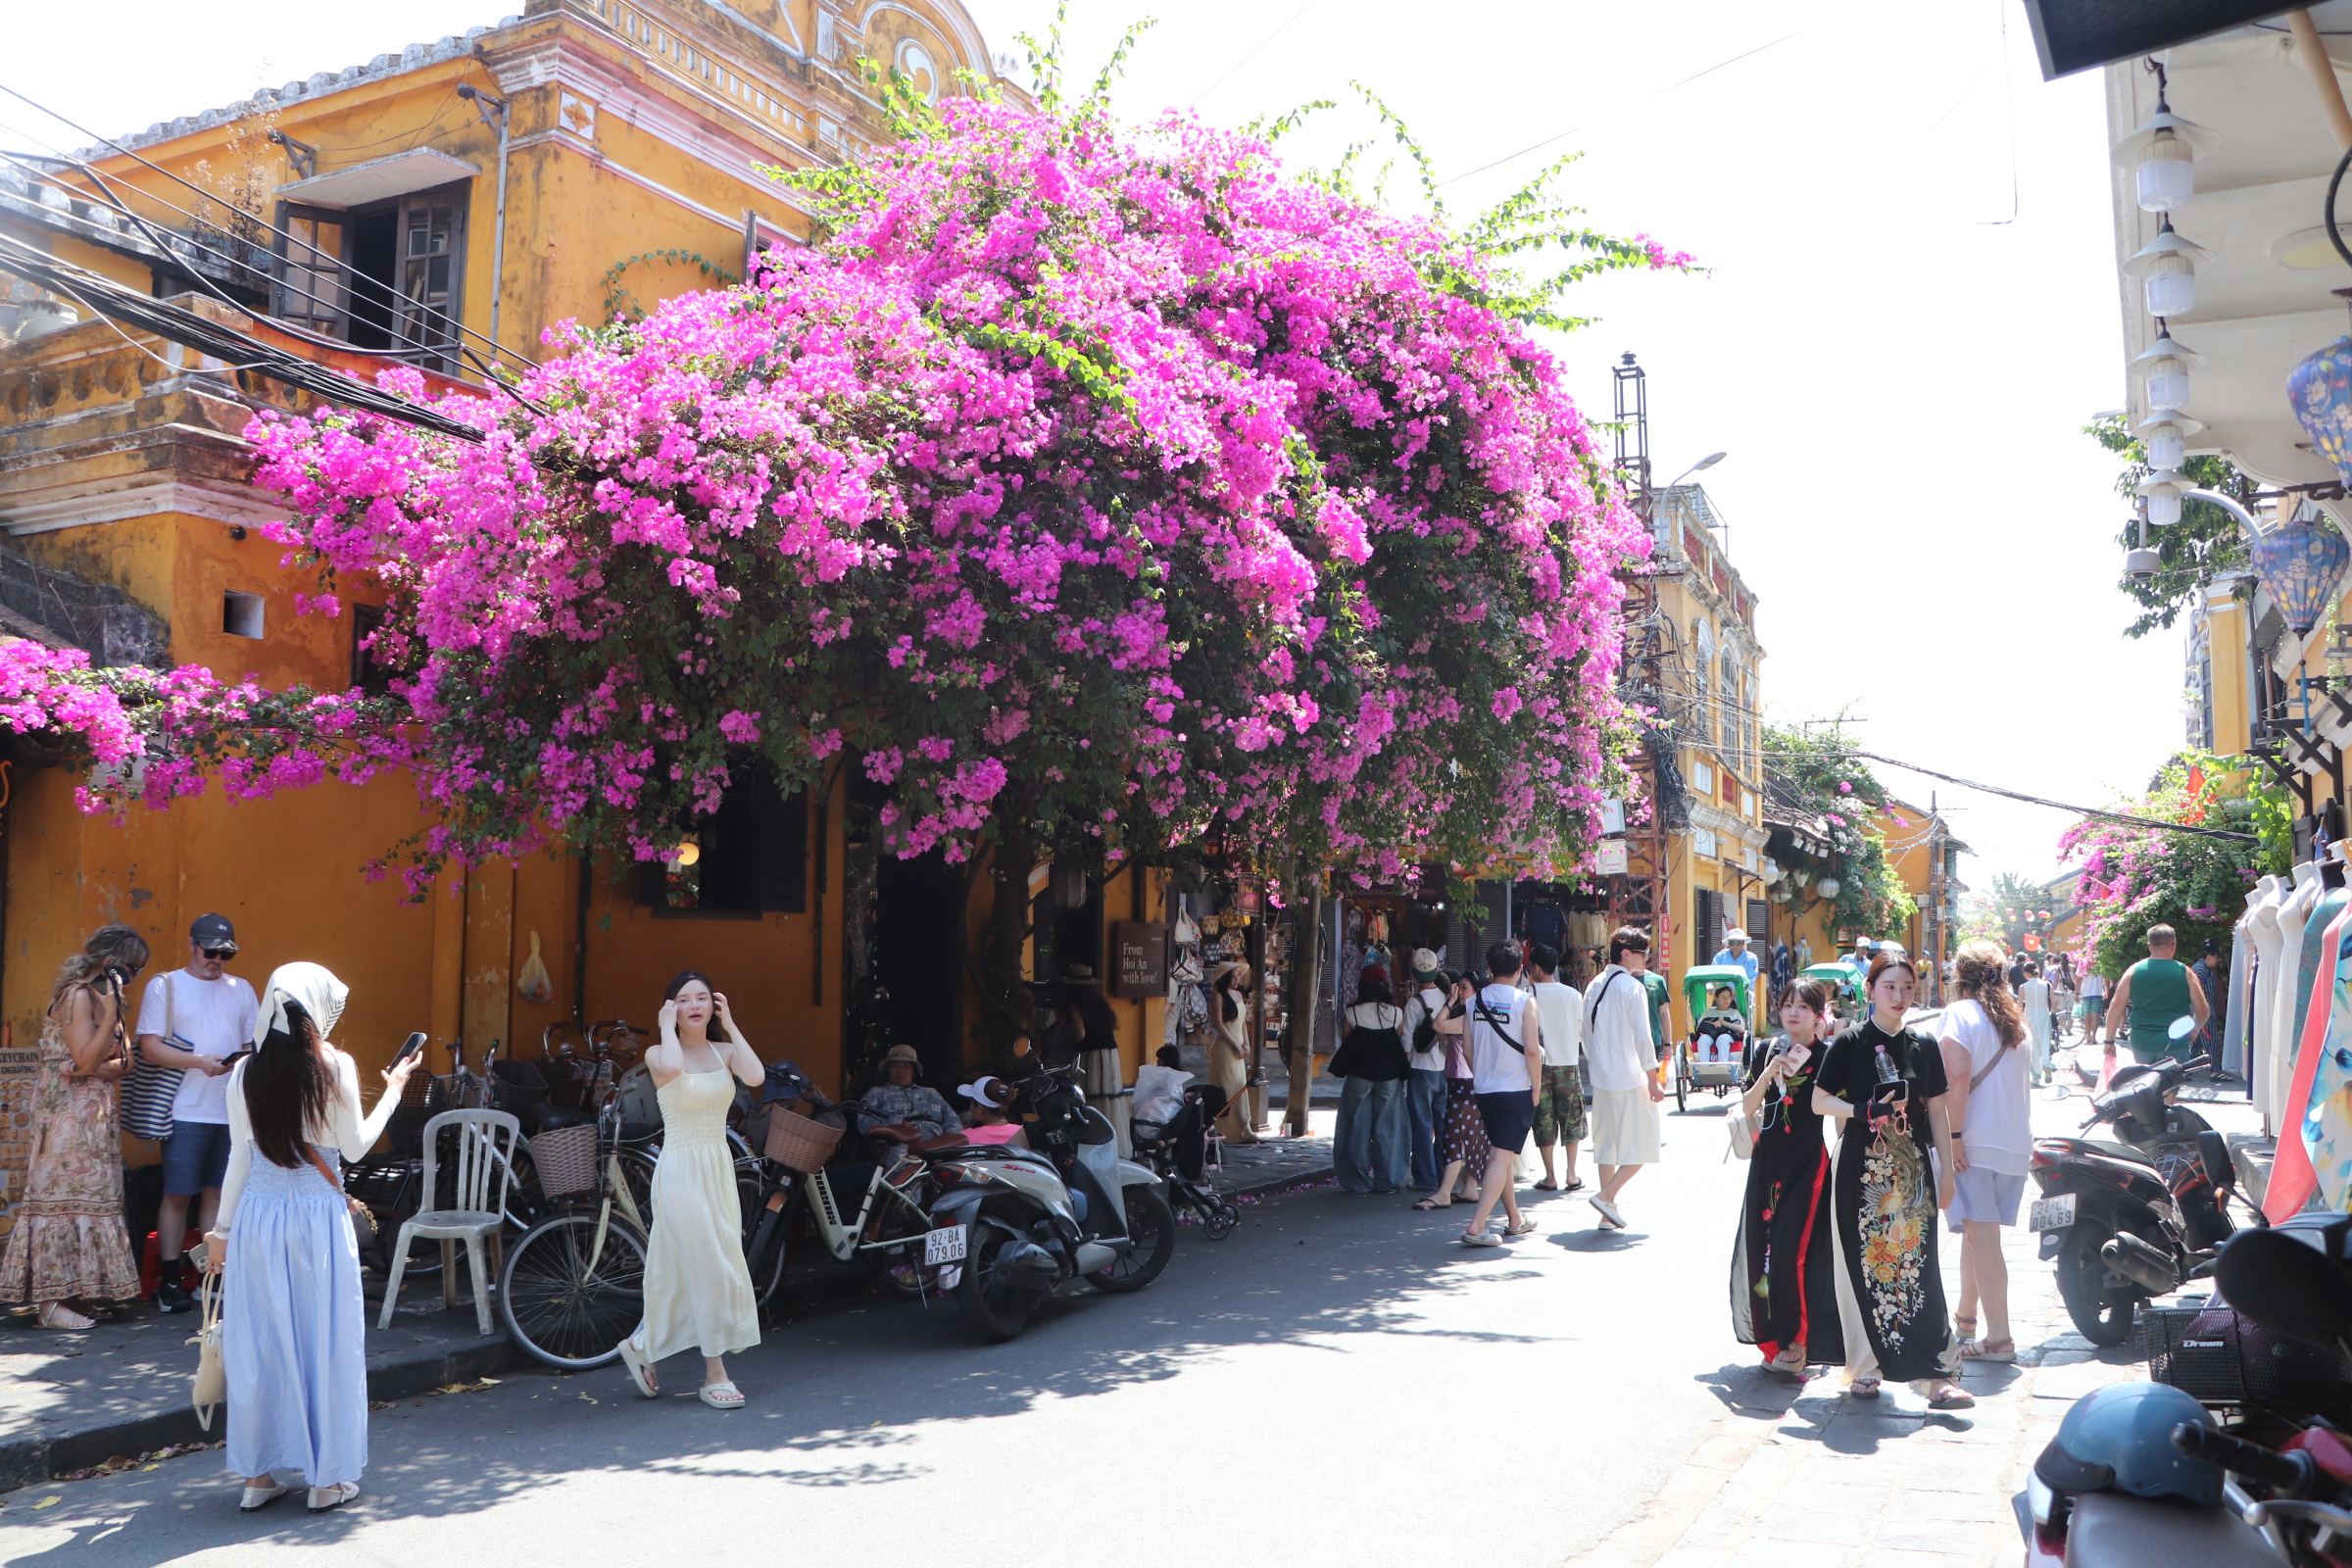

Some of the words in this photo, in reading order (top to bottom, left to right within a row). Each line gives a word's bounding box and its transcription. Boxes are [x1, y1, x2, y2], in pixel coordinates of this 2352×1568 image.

[1122, 942, 1144, 956] From
[1122, 956, 1136, 969] Hoi
[1137, 957, 1148, 970] An
[1122, 971, 1139, 984] with
[1140, 970, 1157, 984] love!
[1, 1065, 36, 1075] ENGRAVING
[2032, 1210, 2072, 1230] 004.69
[931, 1228, 959, 1247] 92-BA
[927, 1242, 964, 1262] 079.06
